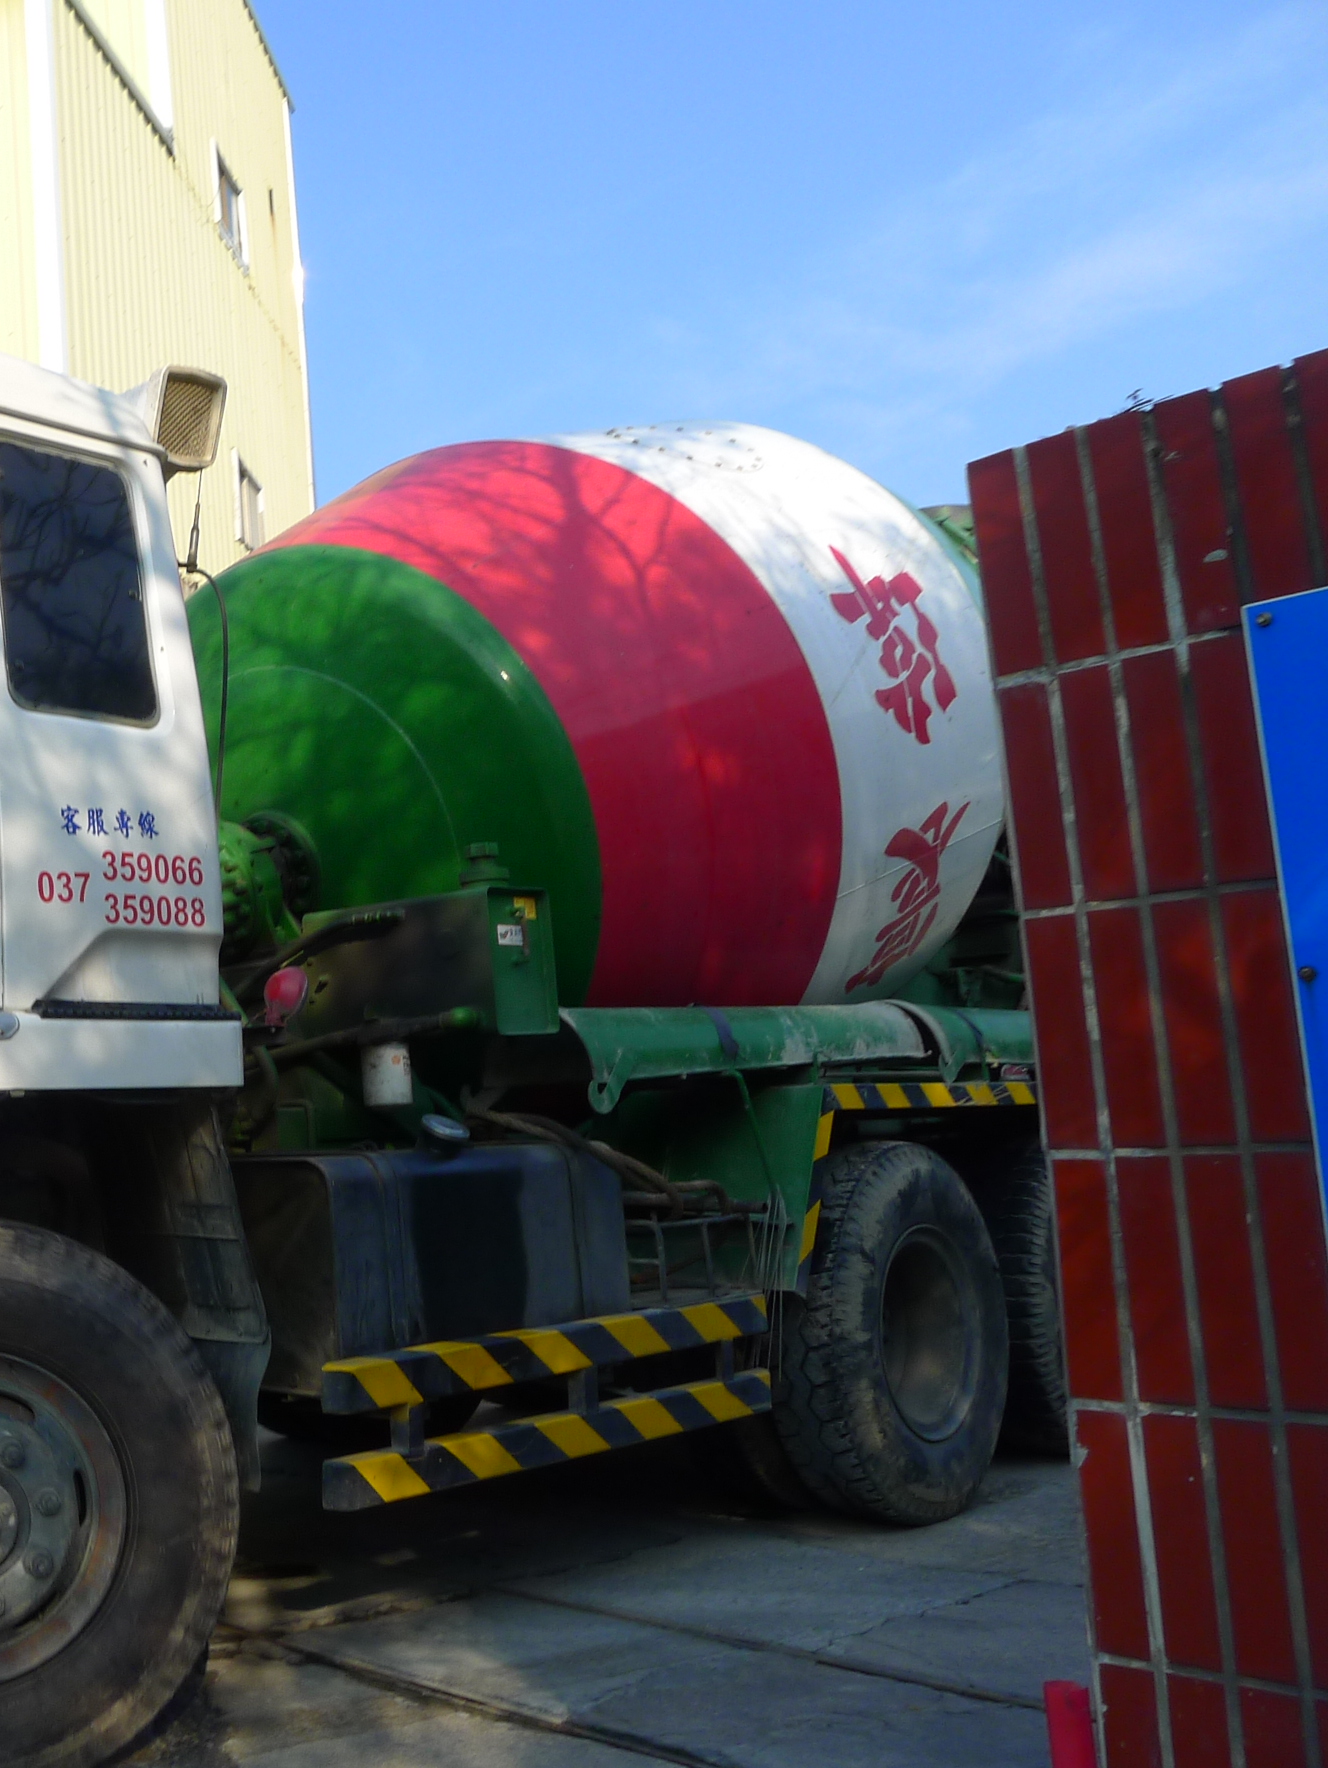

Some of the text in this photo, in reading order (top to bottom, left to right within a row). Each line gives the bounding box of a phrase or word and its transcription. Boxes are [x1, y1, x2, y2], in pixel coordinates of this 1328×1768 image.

[60, 805, 159, 840] 客服專線
[37, 849, 204, 904] 037 359066
[104, 892, 206, 928] 359088
